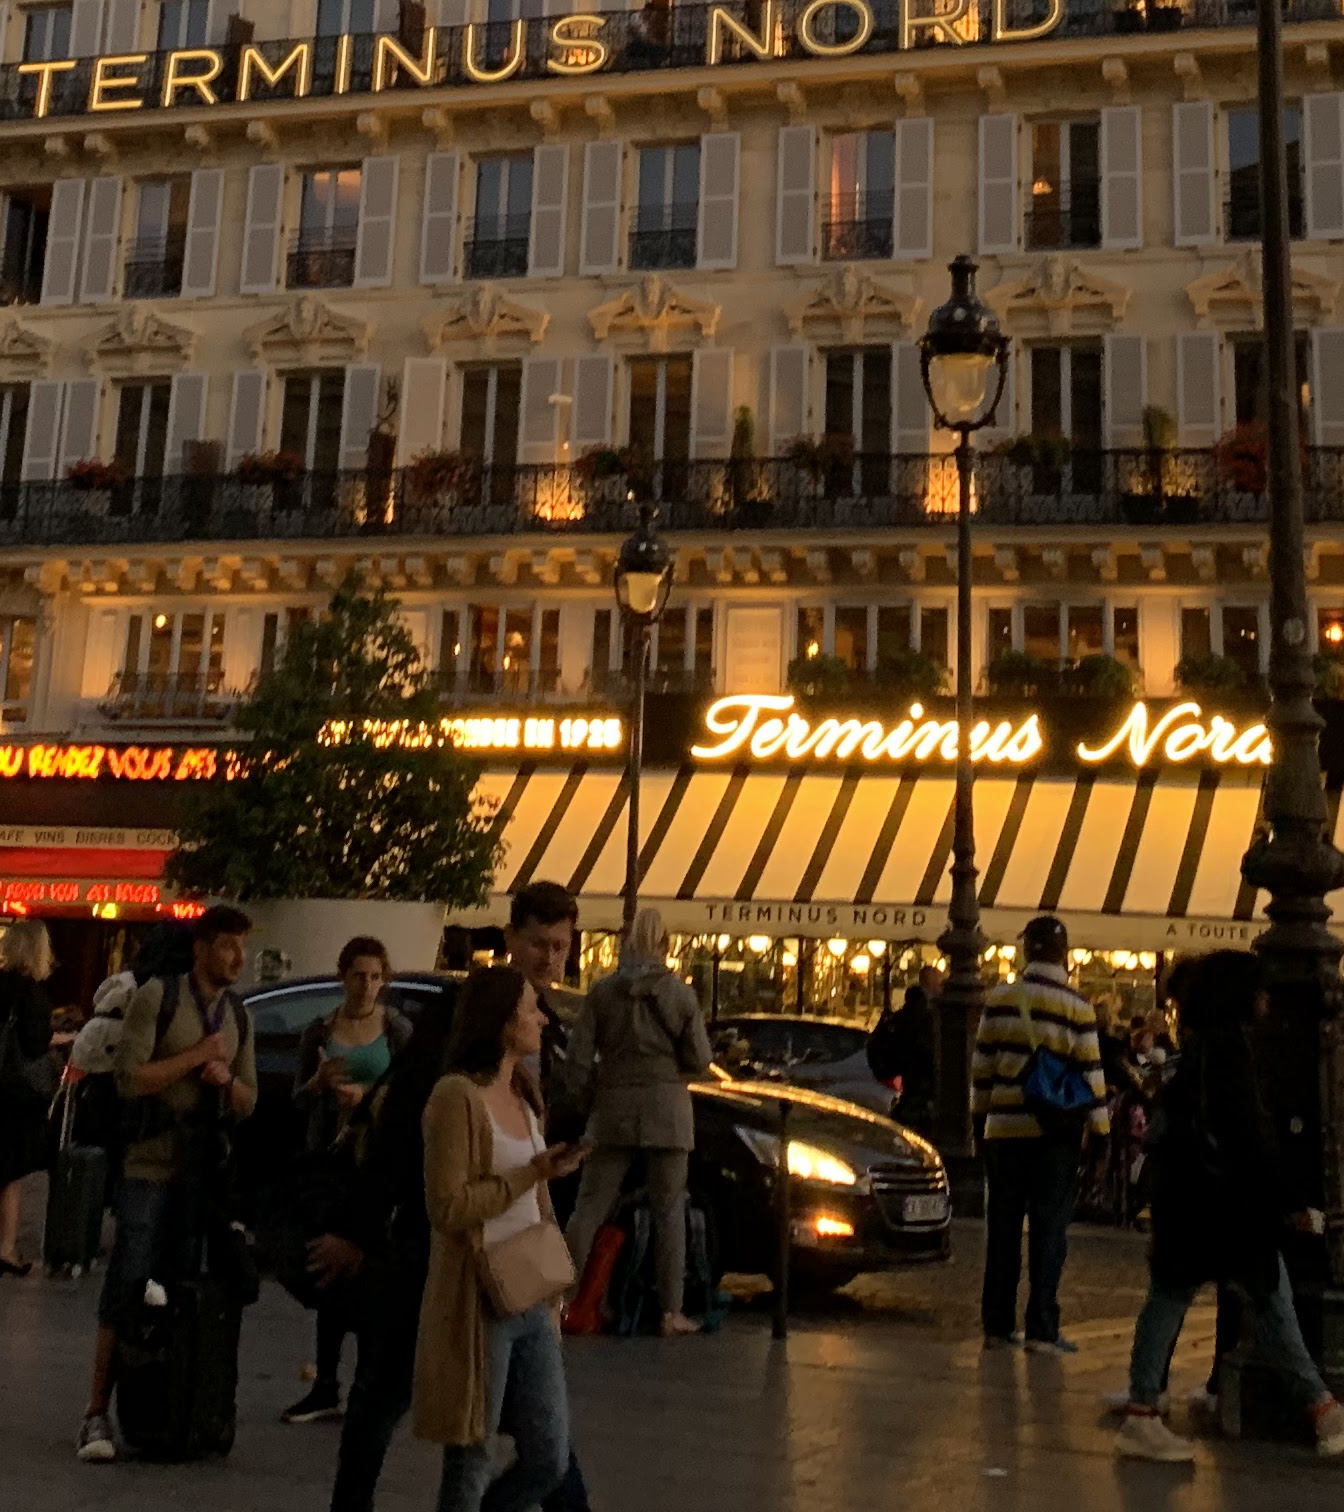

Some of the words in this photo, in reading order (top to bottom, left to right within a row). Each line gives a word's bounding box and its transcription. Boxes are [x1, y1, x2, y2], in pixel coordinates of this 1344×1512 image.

[18, 15, 607, 119] TERMINUS
[691, 694, 1043, 763] Terminus
[27, 744, 105, 779] RENDEZ
[108, 746, 174, 780] VOUS
[707, 904, 838, 925] TERMINUS
[853, 908, 927, 927] NORD
[1186, 923, 1249, 940] TOUTE
